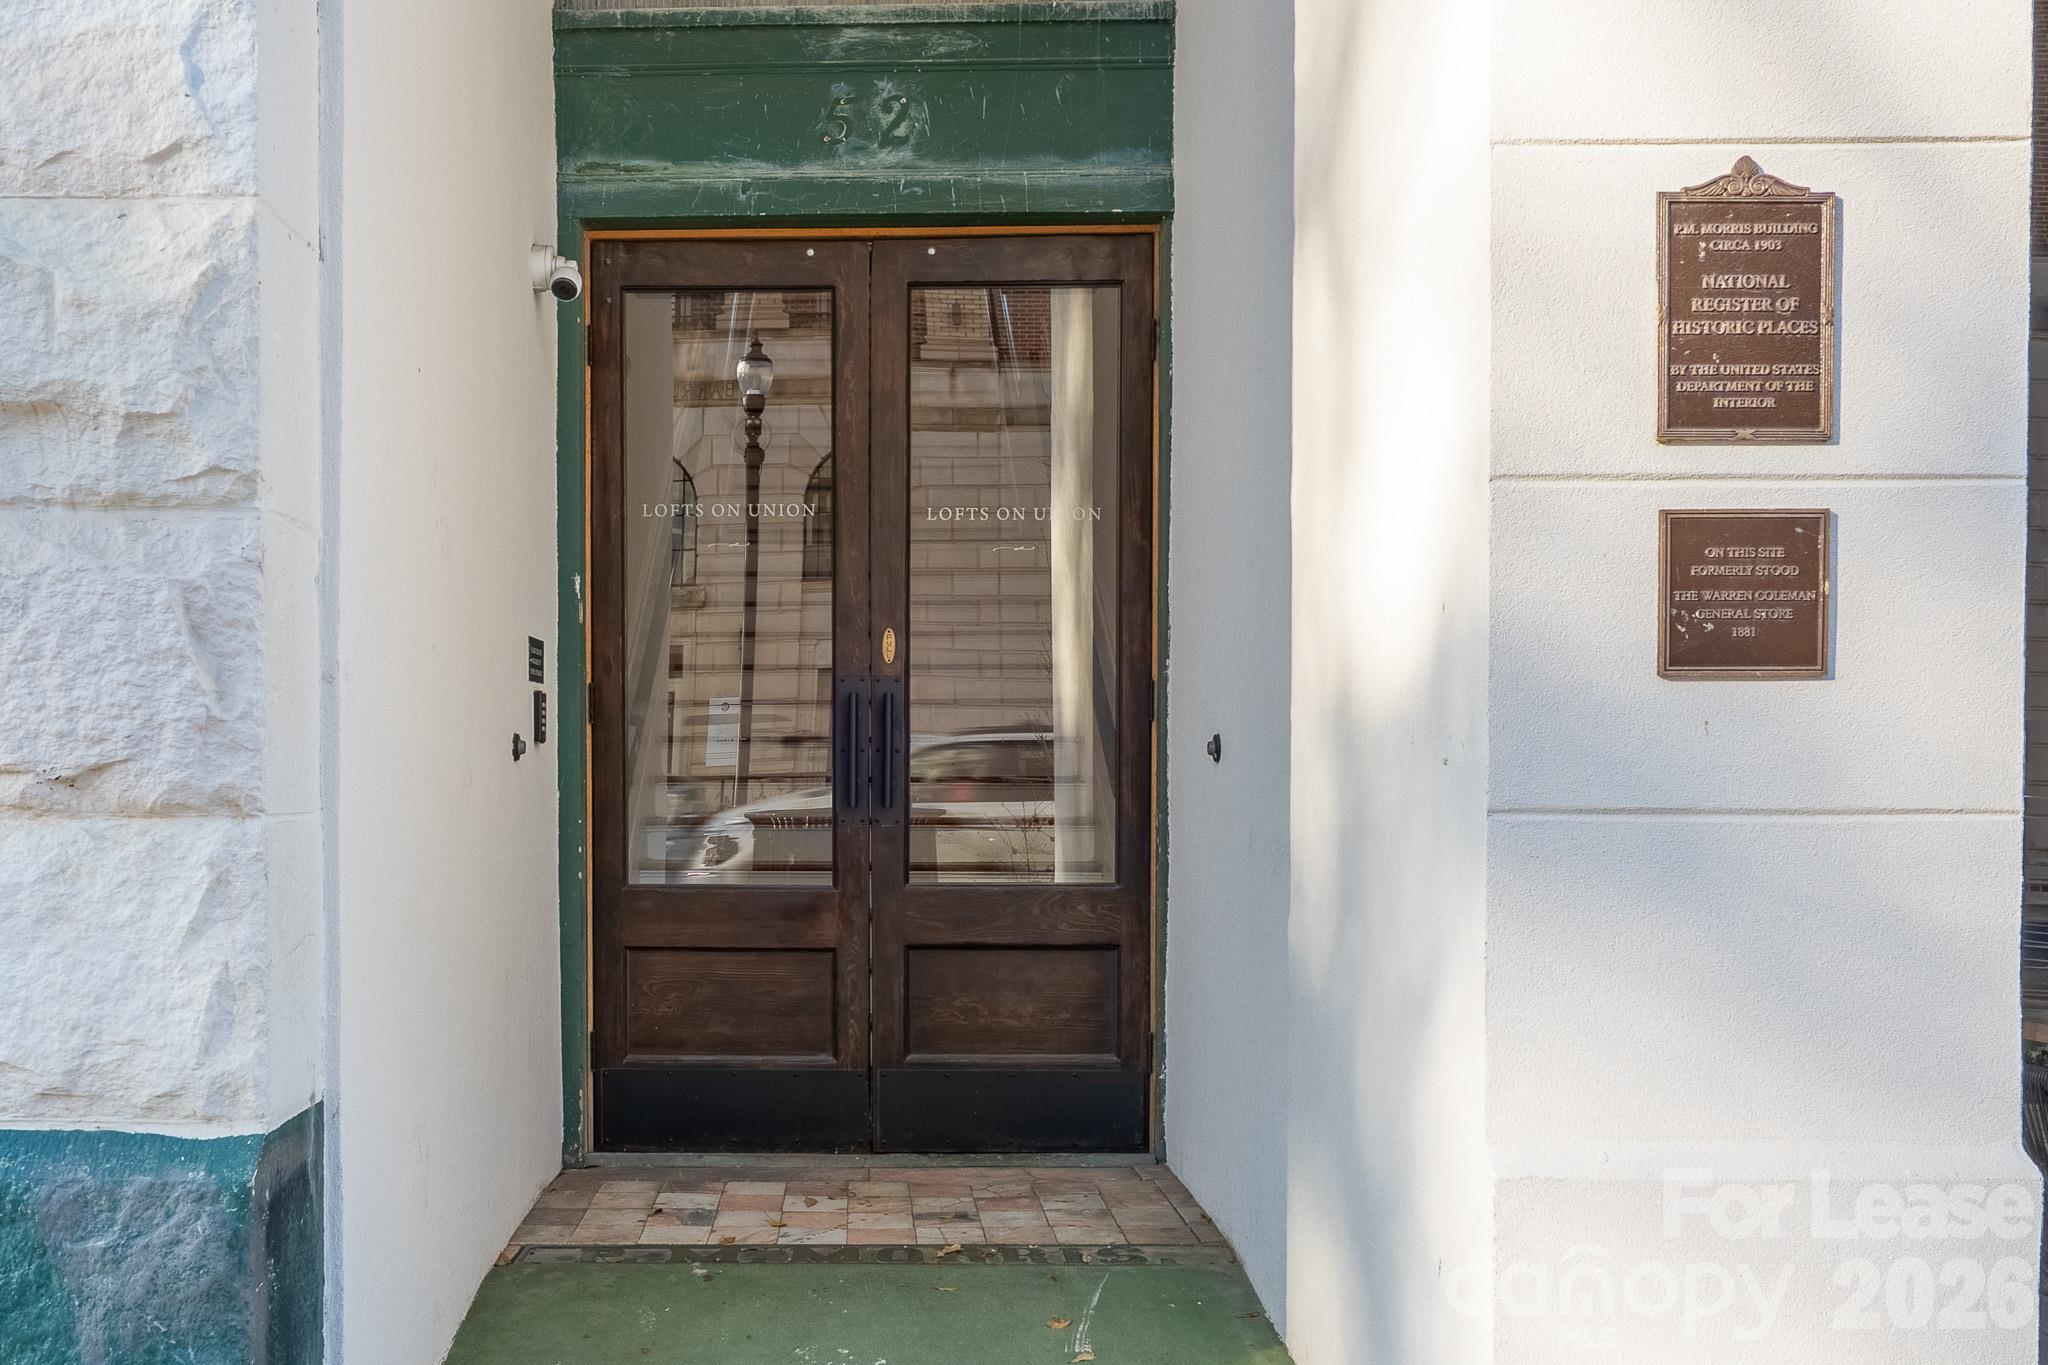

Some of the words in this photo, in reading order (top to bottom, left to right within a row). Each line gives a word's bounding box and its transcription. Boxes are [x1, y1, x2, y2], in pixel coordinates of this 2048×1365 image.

[820, 94, 910, 148] 52
[1673, 223, 1699, 235] P.M.
[1700, 223, 1751, 235] MORRIS
[1752, 223, 1819, 235] BUILDING
[1710, 240, 1750, 251] CIRCA
[1754, 240, 1782, 251] 1903
[1701, 274, 1790, 289] NATIONAL
[1691, 297, 1774, 313] REGISTER
[1776, 297, 1800, 313] OF
[1672, 320, 1755, 335] HISTORIC
[1757, 320, 1819, 335] PLACES
[1670, 365, 1688, 376] BY
[1689, 365, 1718, 376] THE
[1719, 365, 1771, 376] UNITED
[1773, 365, 1820, 376] STATES
[1676, 381, 1764, 392] DEPARTMENT
[1765, 381, 1785, 392] OF
[1786, 381, 1814, 392] THE
[1713, 397, 1776, 408] INTERIOR
[642, 503, 704, 517] LOFTS
[711, 503, 741, 517] ON
[748, 503, 816, 517] UNION
[926, 507, 989, 521] LOFTS
[996, 507, 1026, 521] ON
[1034, 507, 1102, 521] UON
[1705, 547, 1725, 558] ON
[1727, 547, 1755, 558] THIS
[1758, 547, 1785, 558] SITE
[1691, 565, 1753, 577] FORMERLY
[1755, 565, 1800, 577] STOOD
[1673, 590, 1699, 601] THE
[1701, 590, 1753, 601] WARREN
[1754, 590, 1816, 601] COLEMAN
[1696, 609, 1751, 620] GENERAL
[1753, 609, 1794, 620] STORE
[1731, 627, 1757, 638] 1881
